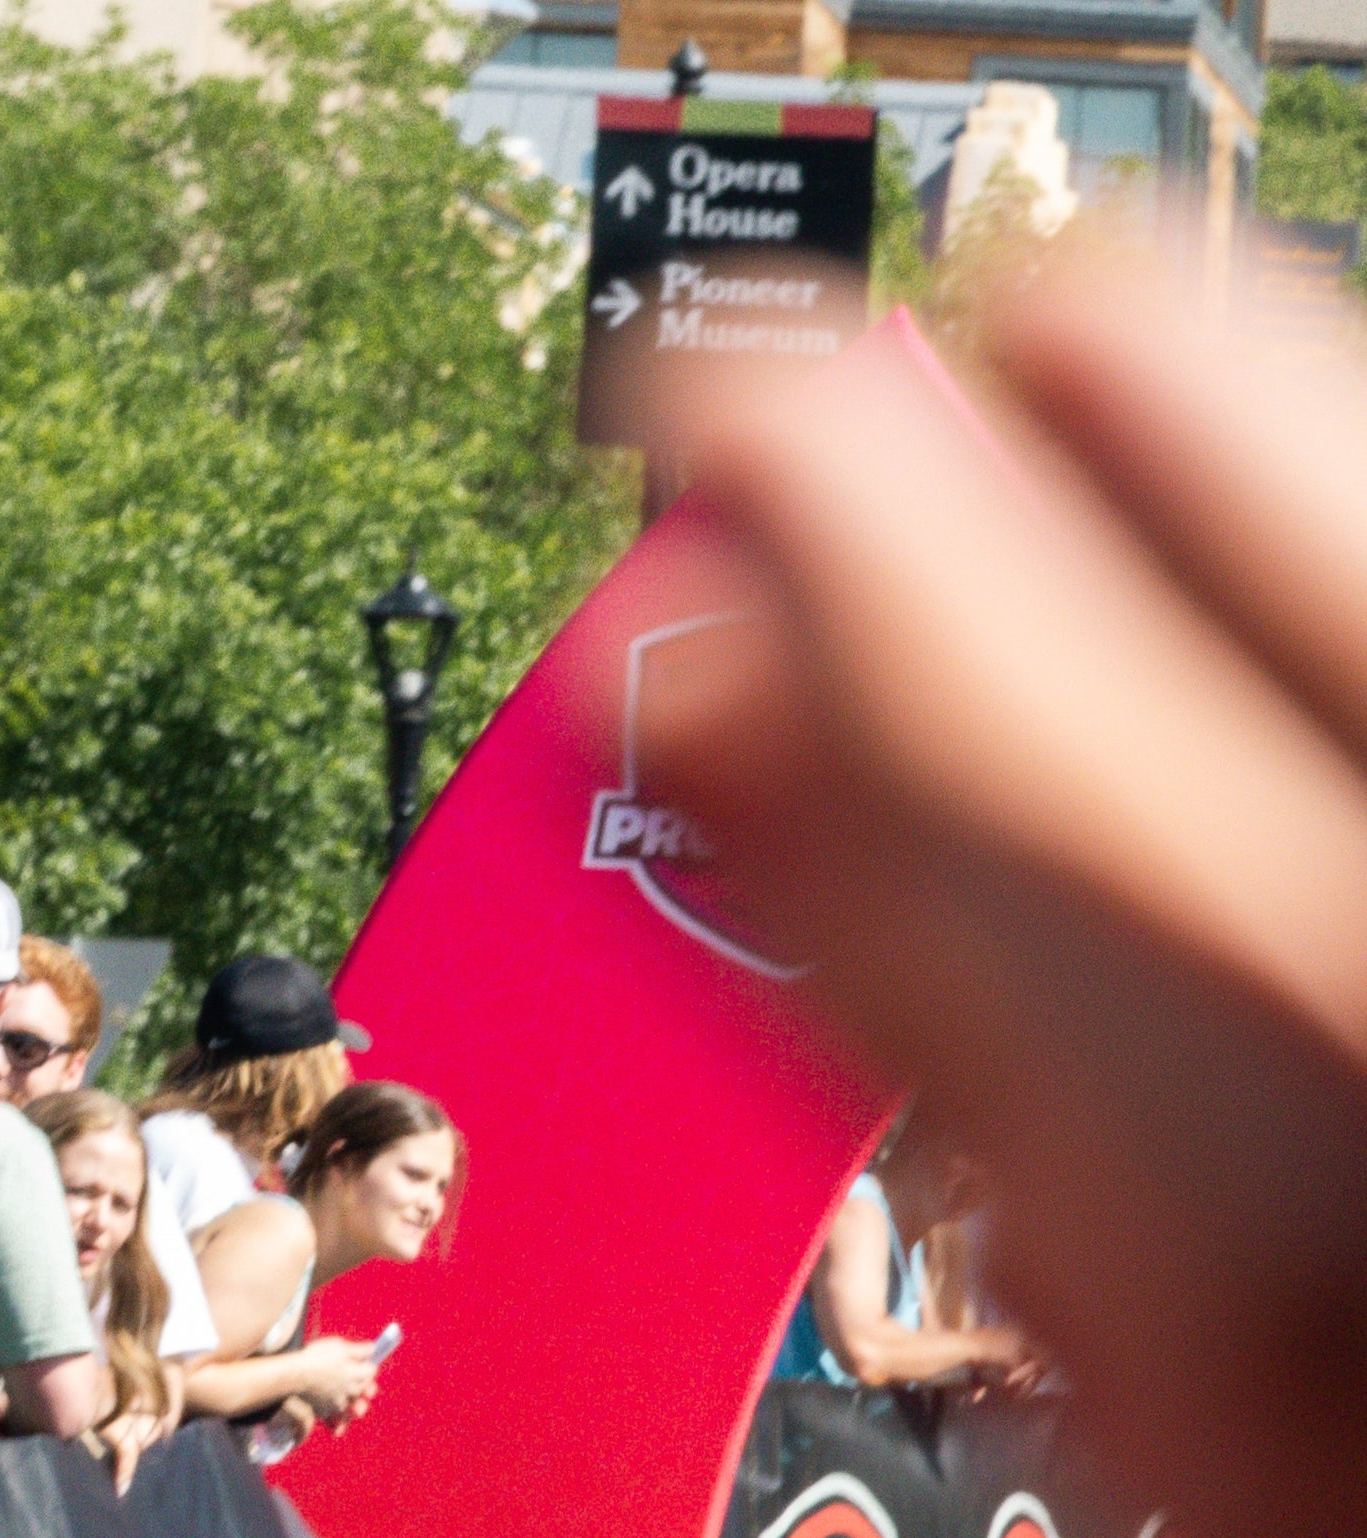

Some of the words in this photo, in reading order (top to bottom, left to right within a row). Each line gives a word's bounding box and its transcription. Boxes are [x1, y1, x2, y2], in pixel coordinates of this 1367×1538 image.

[669, 145, 803, 197] Opera
[667, 193, 799, 239] House
[660, 263, 820, 308] Pioneer
[658, 309, 839, 354] Museum
